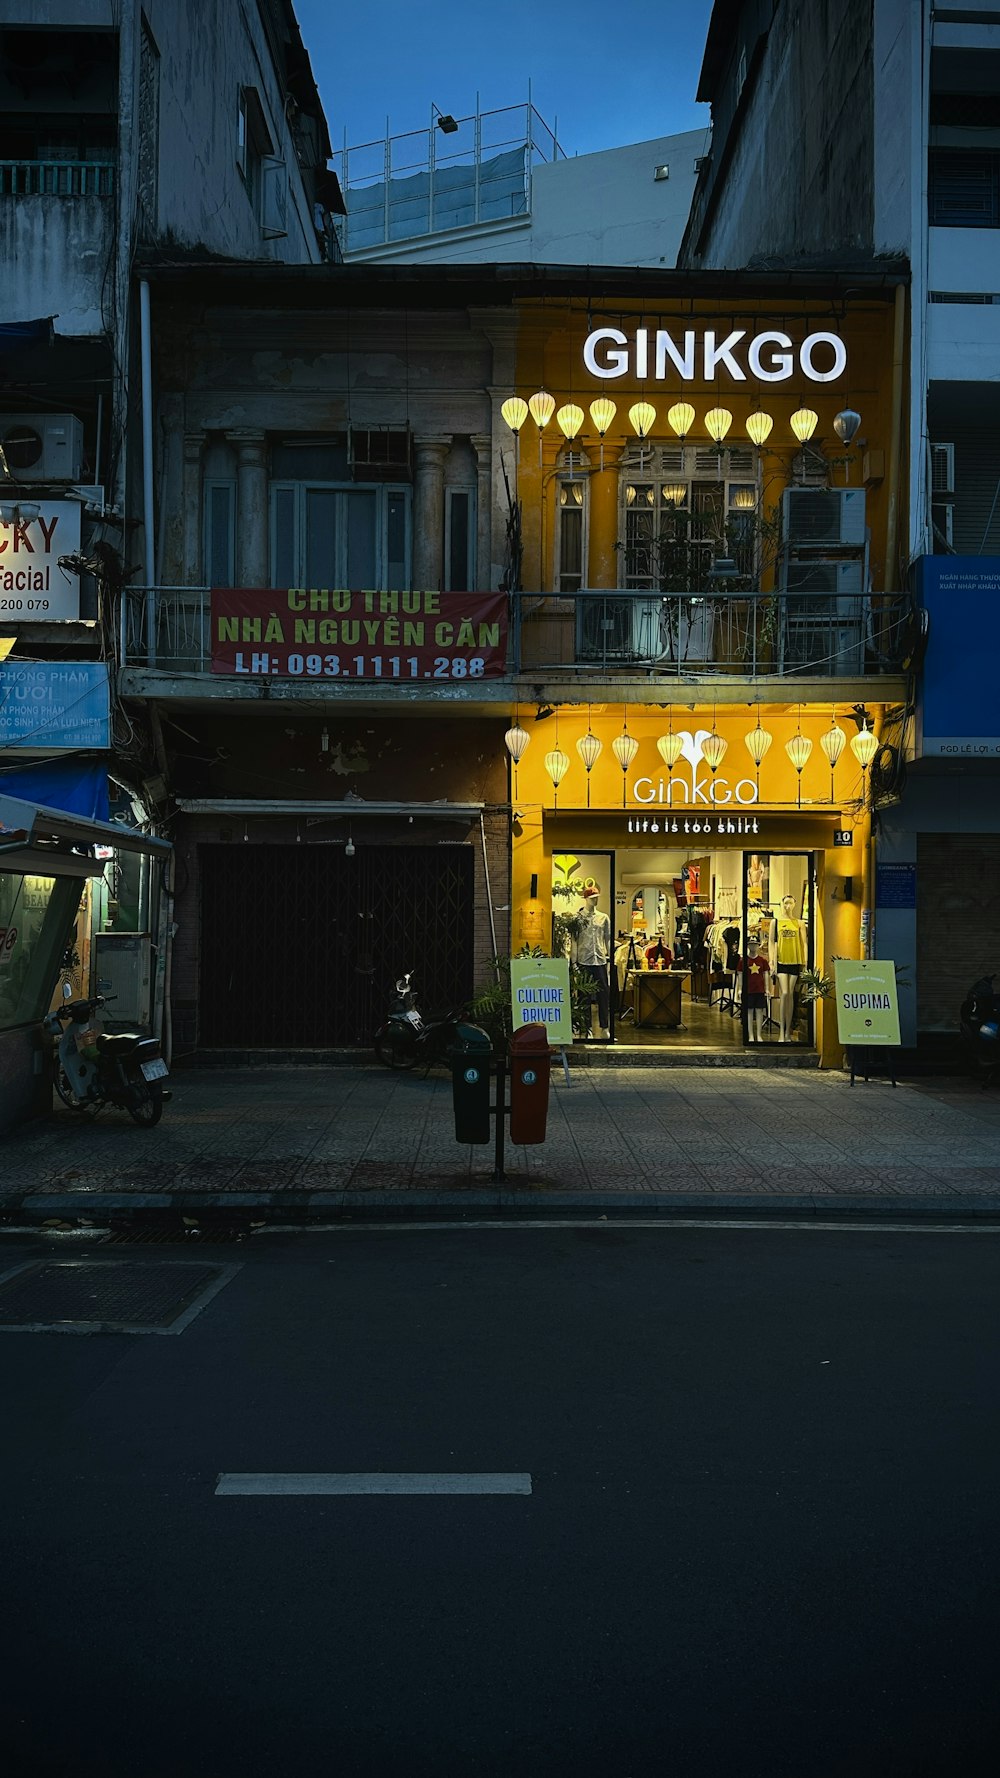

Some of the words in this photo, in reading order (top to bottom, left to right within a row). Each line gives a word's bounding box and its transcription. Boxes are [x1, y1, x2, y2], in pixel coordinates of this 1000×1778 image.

[583, 328, 847, 382] GINKGO
[0, 600, 23, 610] 200
[27, 600, 49, 610] 079
[287, 588, 352, 612] CHO
[218, 612, 285, 643] NHÀ
[294, 616, 425, 647] NGUYÊN
[434, 617, 500, 648] CĂN
[235, 652, 279, 674] LH:
[287, 653, 485, 678] 093.1111.288
[940, 745, 959, 753] PGD
[961, 744, 971, 753] LÊ
[628, 821, 659, 834] life
[664, 821, 679, 834] is
[683, 821, 712, 834] too
[717, 821, 760, 835] shirt
[835, 832, 851, 842] 10
